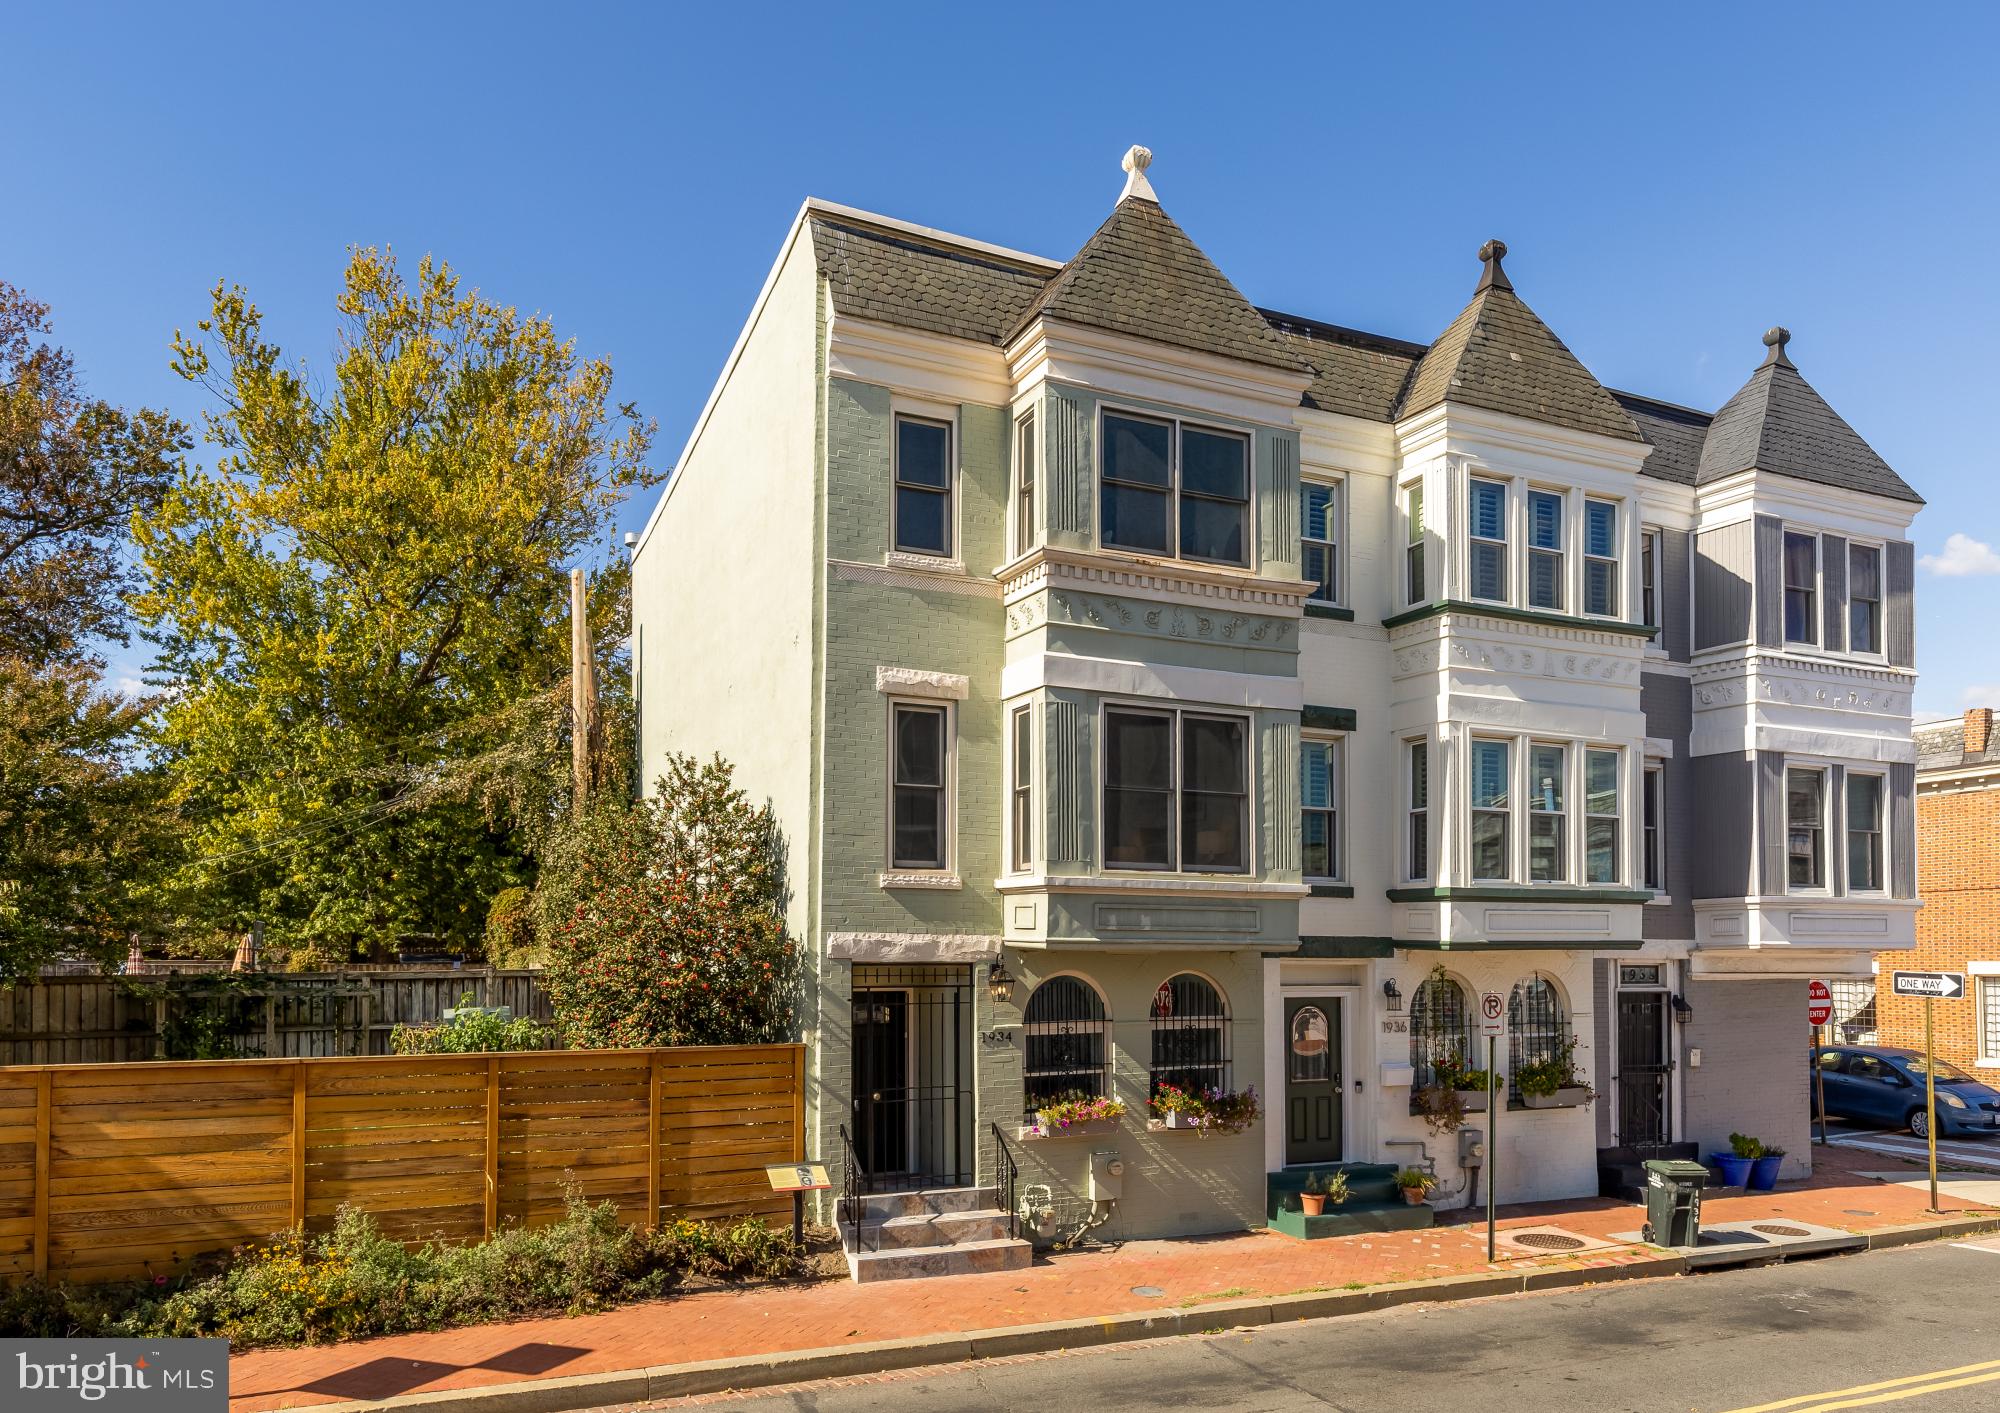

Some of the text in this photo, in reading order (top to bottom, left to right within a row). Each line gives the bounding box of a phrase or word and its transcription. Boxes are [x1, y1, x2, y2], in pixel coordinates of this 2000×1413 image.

[1900, 979, 1941, 989] ONE WAY
[1382, 1021, 1408, 1033] 1936
[982, 1031, 1012, 1043] 1934
